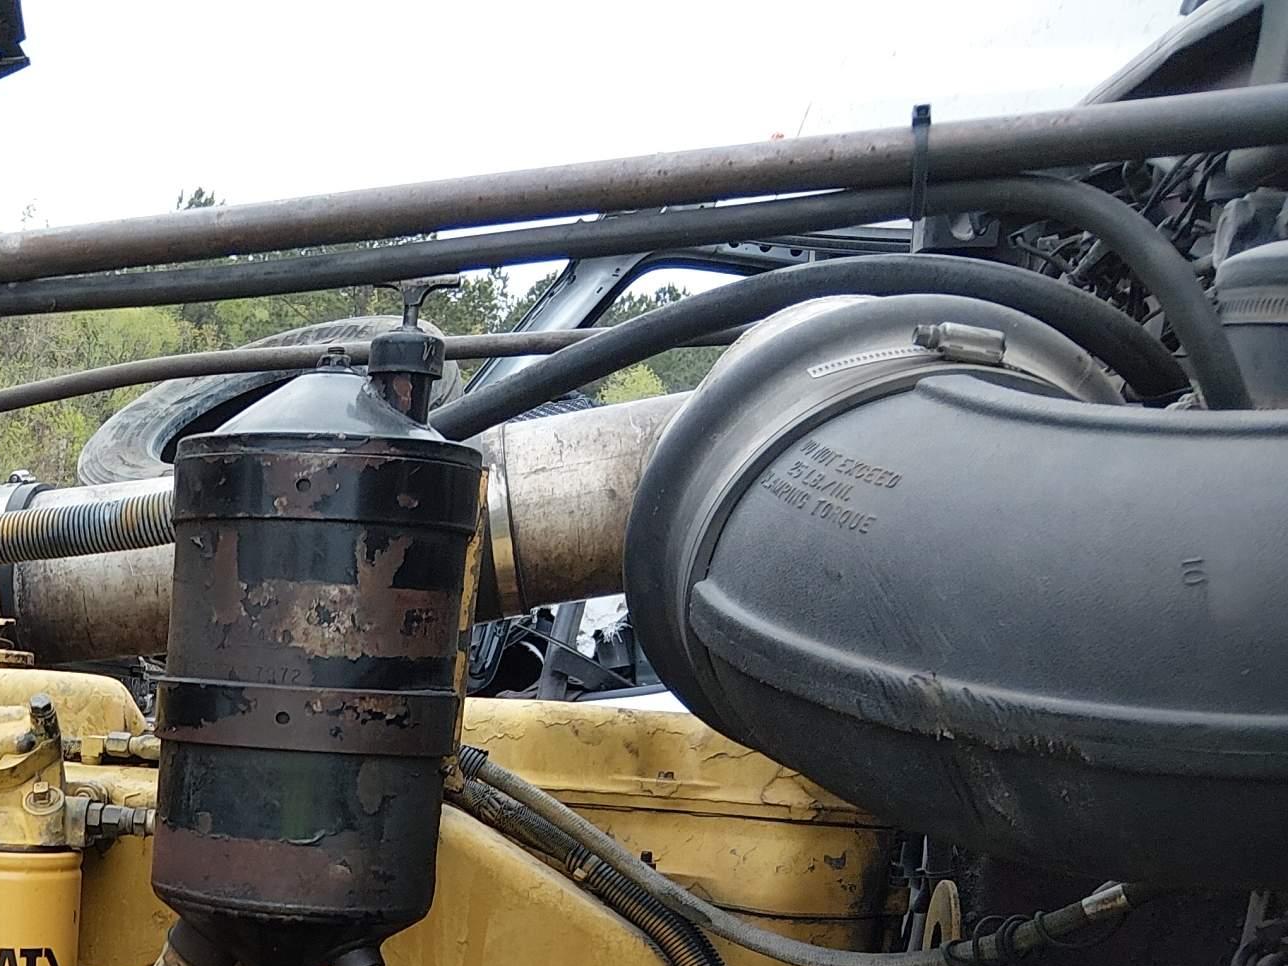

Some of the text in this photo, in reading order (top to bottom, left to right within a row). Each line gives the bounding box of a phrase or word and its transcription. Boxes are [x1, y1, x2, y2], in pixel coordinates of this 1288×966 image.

[787, 460, 809, 480] 25
[834, 457, 904, 489] EXCEED
[810, 499, 879, 534] TORQUE
